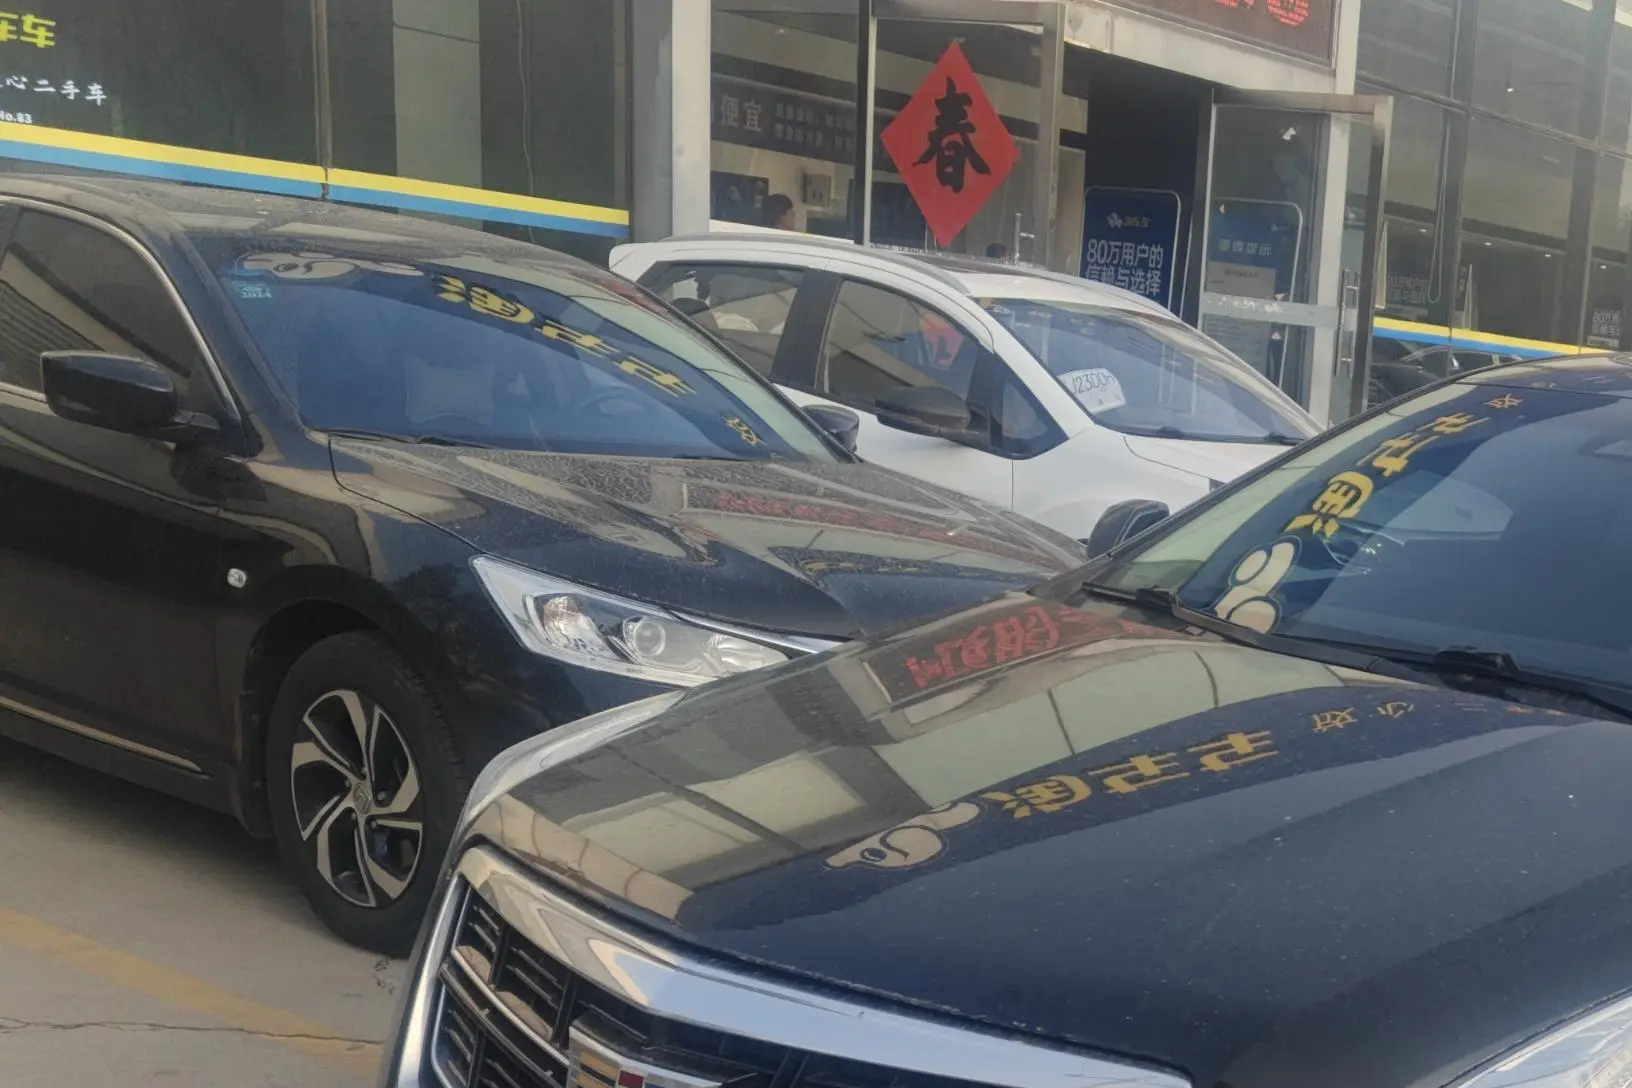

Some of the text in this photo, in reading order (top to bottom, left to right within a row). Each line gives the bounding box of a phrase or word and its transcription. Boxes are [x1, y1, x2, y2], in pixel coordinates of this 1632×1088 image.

[0, 75, 107, 106] 心二手车
[711, 94, 763, 132] 便宜
[912, 76, 992, 193] 春
[1086, 238, 1164, 269] 80万用户的
[1085, 263, 1162, 297] 信赖与选择
